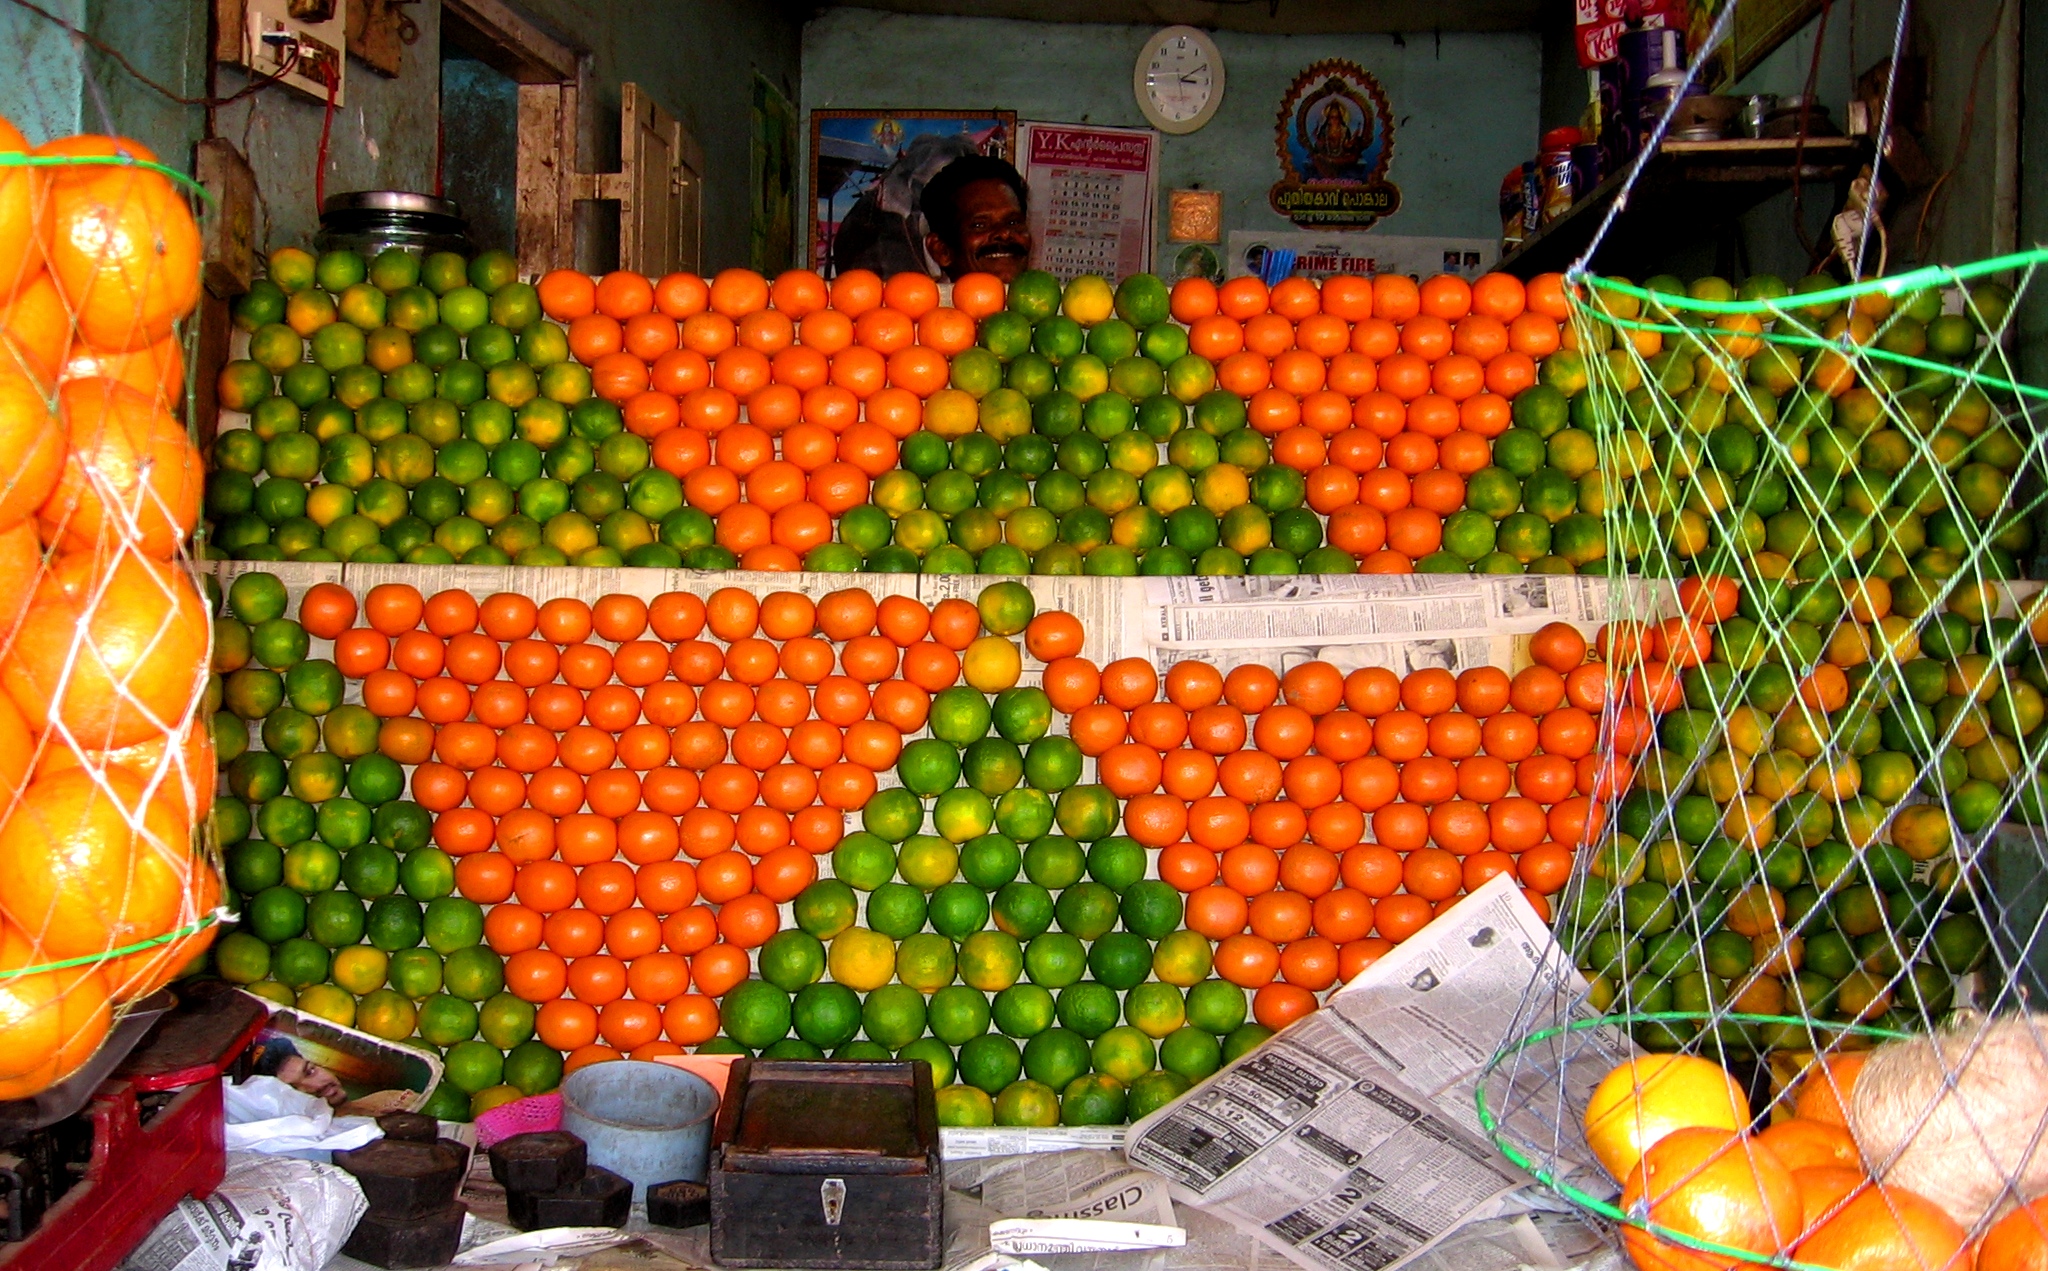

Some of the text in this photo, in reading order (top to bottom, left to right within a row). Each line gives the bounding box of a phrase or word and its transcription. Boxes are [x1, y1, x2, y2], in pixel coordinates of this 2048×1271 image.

[1177, 40, 1186, 49] 12
[1160, 48, 1167, 56] 11
[1151, 62, 1160, 70] 10
[1175, 112, 1181, 120] 6
[1037, 131, 1072, 151] Y.K
[1293, 256, 1338, 271] RIME
[1341, 257, 1376, 272] FIRE
[1225, 1109, 1245, 1123] 12
[1335, 1188, 1363, 1206] 2
[1338, 1230, 1363, 1245] 2
